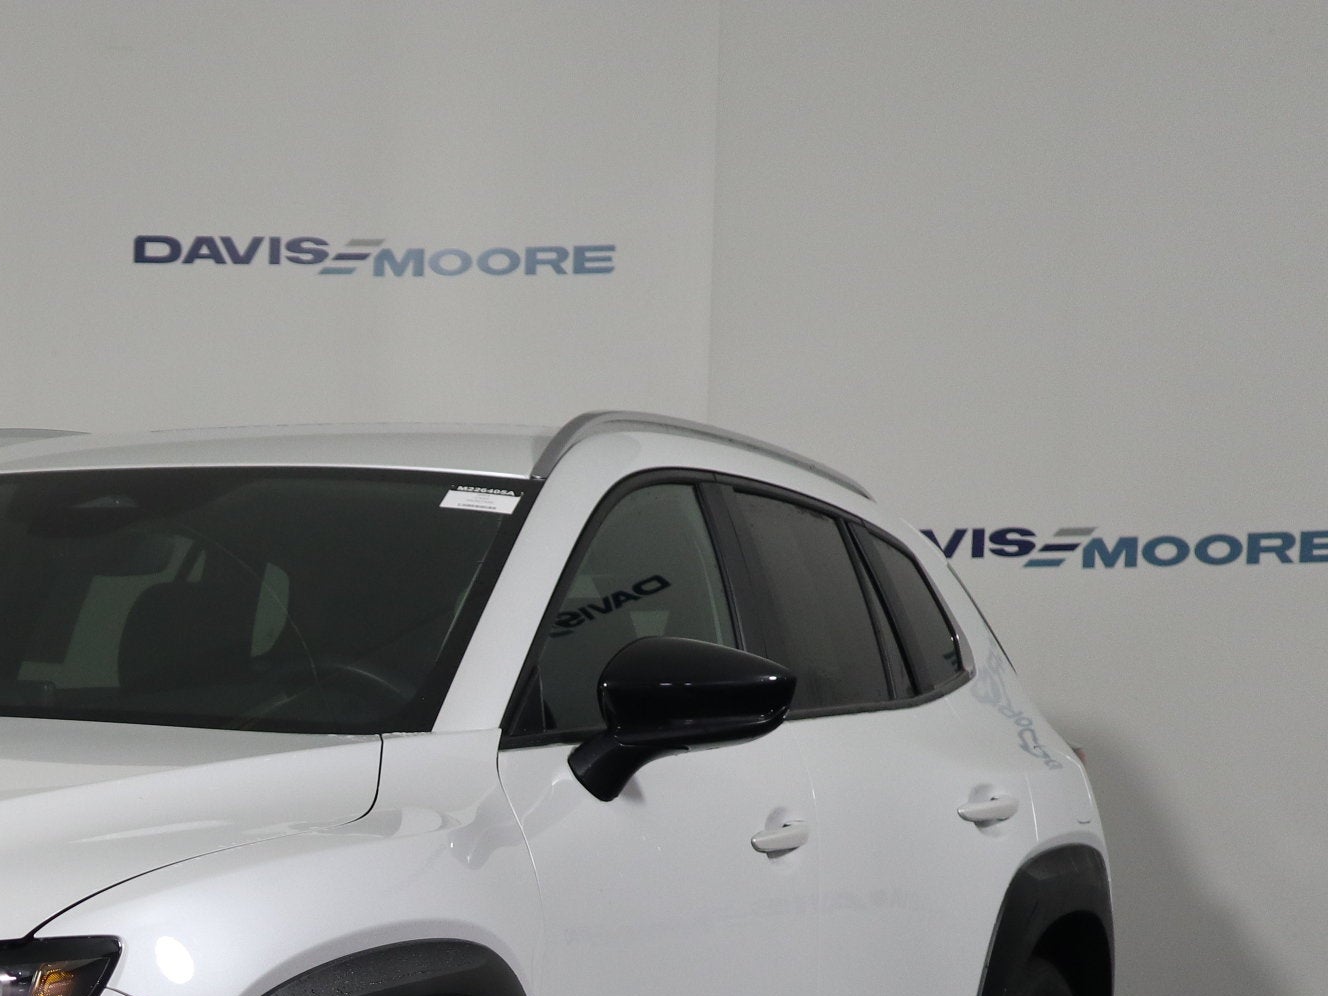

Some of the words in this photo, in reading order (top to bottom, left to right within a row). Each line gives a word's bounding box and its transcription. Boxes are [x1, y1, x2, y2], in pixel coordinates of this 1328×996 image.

[133, 235, 330, 265] DAVIS
[372, 244, 616, 278] MOORE
[920, 526, 1037, 559] VIS
